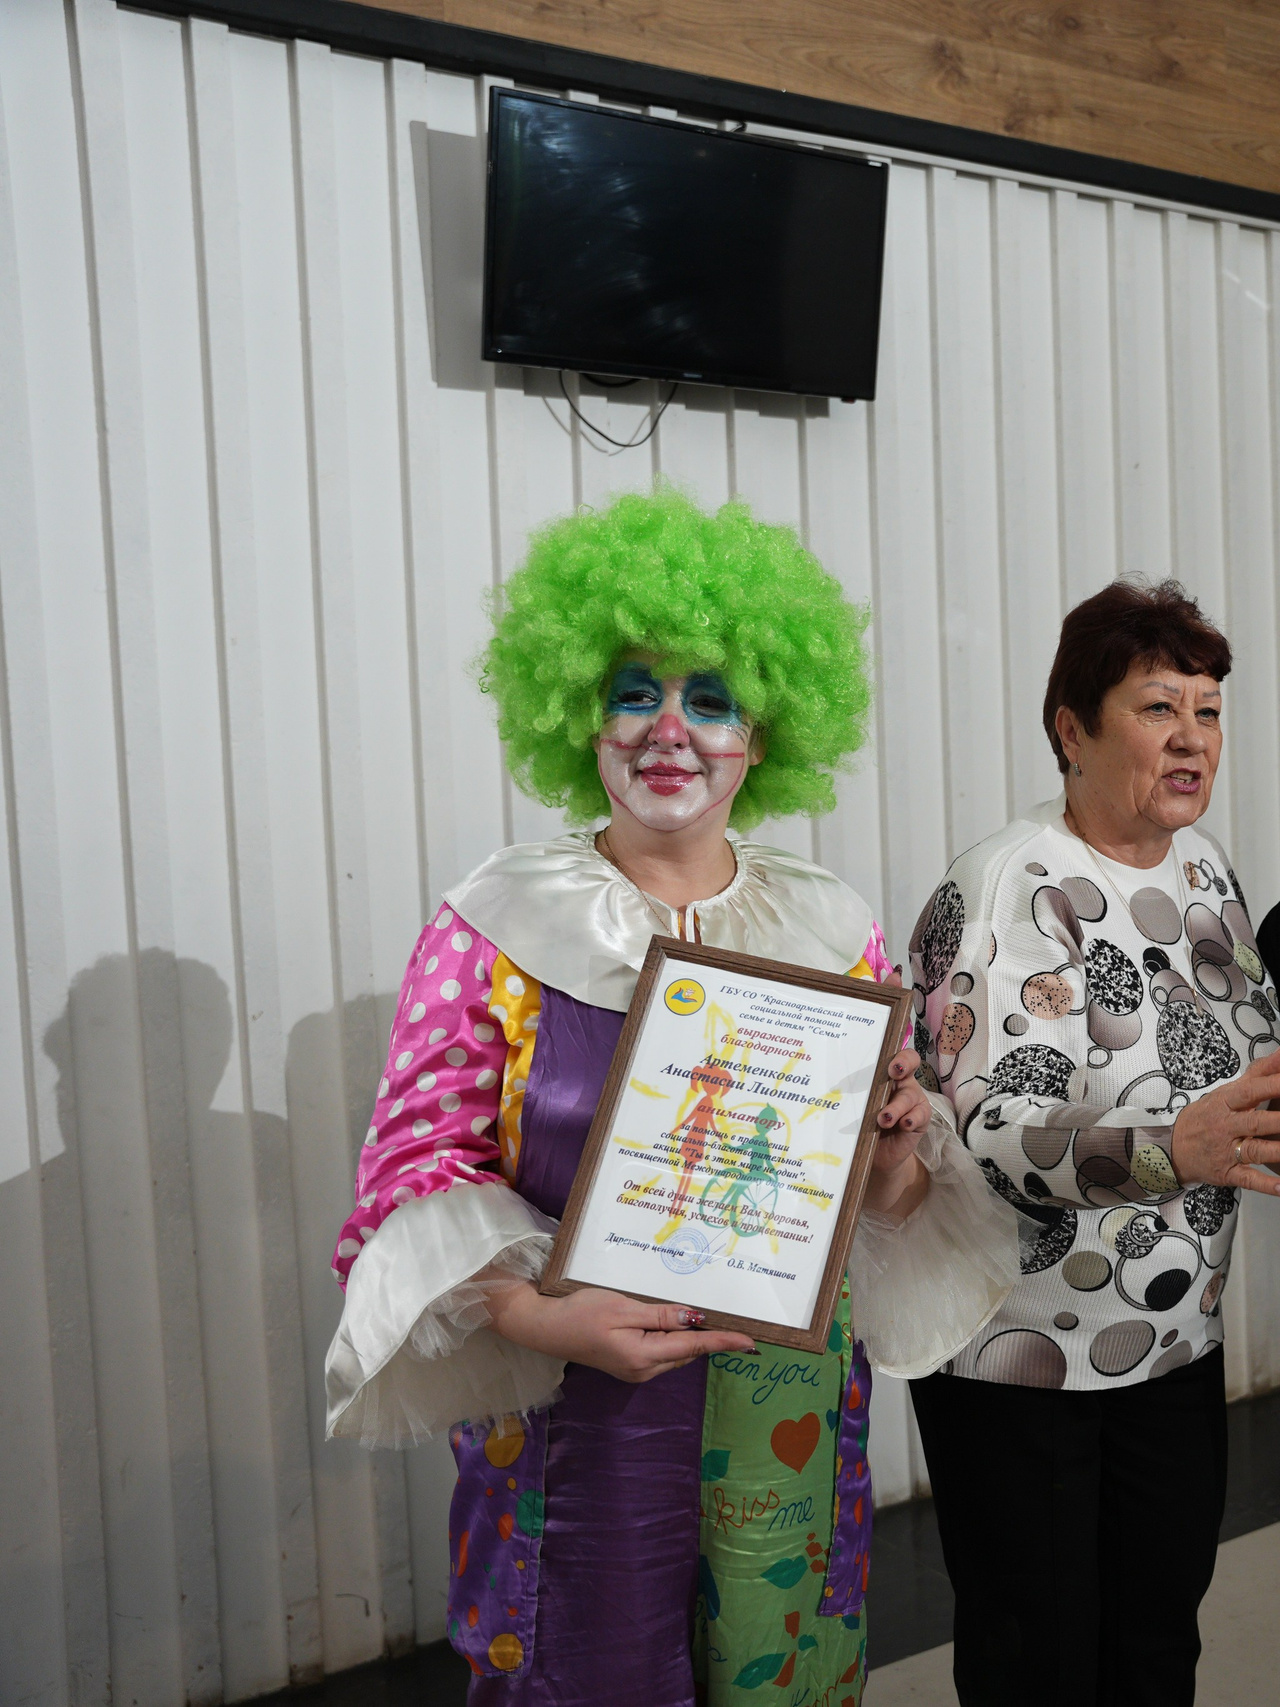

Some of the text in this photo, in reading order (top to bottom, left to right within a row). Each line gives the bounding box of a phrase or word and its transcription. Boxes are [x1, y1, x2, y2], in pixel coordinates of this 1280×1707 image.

[719, 985, 742, 995] ГБУ
[742, 990, 757, 999] СО
[845, 1013, 875, 1026] центр
[738, 1012, 765, 1022] семье
[774, 1018, 804, 1031] детям
[749, 1004, 841, 1028] социальной помощи
[719, 1033, 811, 1061] благодарность
[736, 1027, 803, 1047] выражает
[659, 1062, 840, 1110] Анастасии Лионтьевне
[699, 1053, 810, 1086] Артеменковой
[696, 1105, 785, 1130] аниматору
[679, 1122, 691, 1131] за
[691, 1125, 728, 1140] помощь
[736, 1135, 790, 1152] проведении
[617, 1147, 680, 1166] посвященной
[786, 1183, 834, 1199] инвалидов
[652, 1142, 681, 1154] акции
[711, 1155, 737, 1166] этом
[735, 1161, 762, 1172] мире
[615, 1193, 814, 1243] благополучия, успехов и процветания!
[623, 1179, 809, 1230] От всей души желаем Вам здоровья,
[604, 1231, 796, 1280] Директор центра О.В. Матяшова
[752, 1362, 820, 1405] you
[713, 1487, 815, 1535] kiss me
